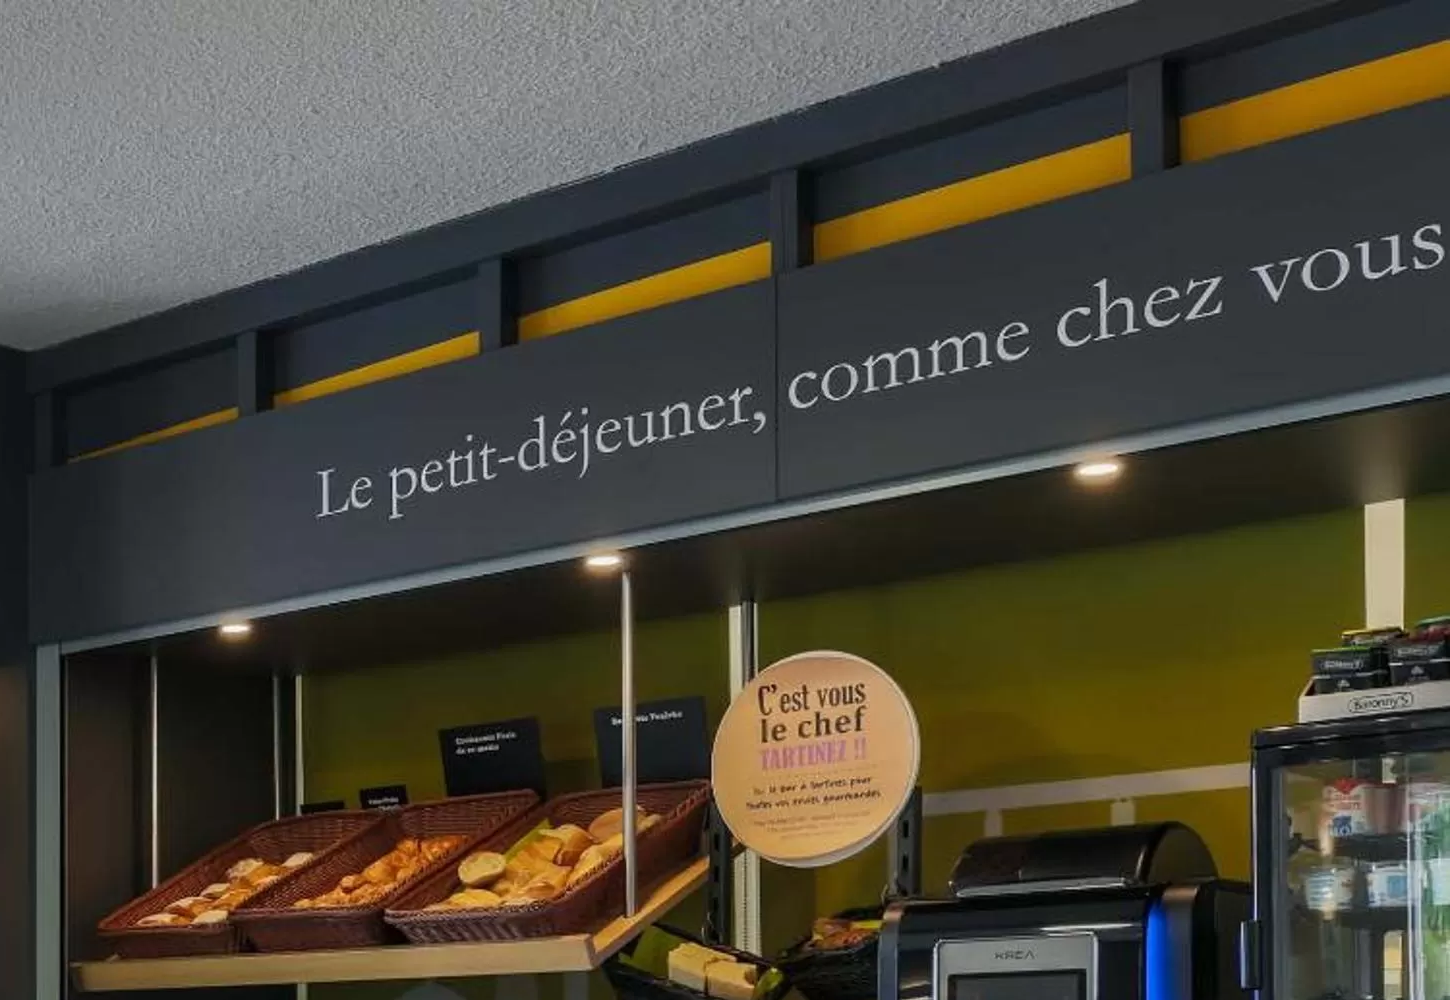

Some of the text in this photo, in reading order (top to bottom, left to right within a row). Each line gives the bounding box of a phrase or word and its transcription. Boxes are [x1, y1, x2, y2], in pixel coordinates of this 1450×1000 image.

[315, 222, 1446, 520] Le petit-déjeuner, comme chez vous
[758, 683, 866, 716] C'est vous
[760, 705, 868, 743] le chef
[760, 739, 847, 770] TARTINEZ
